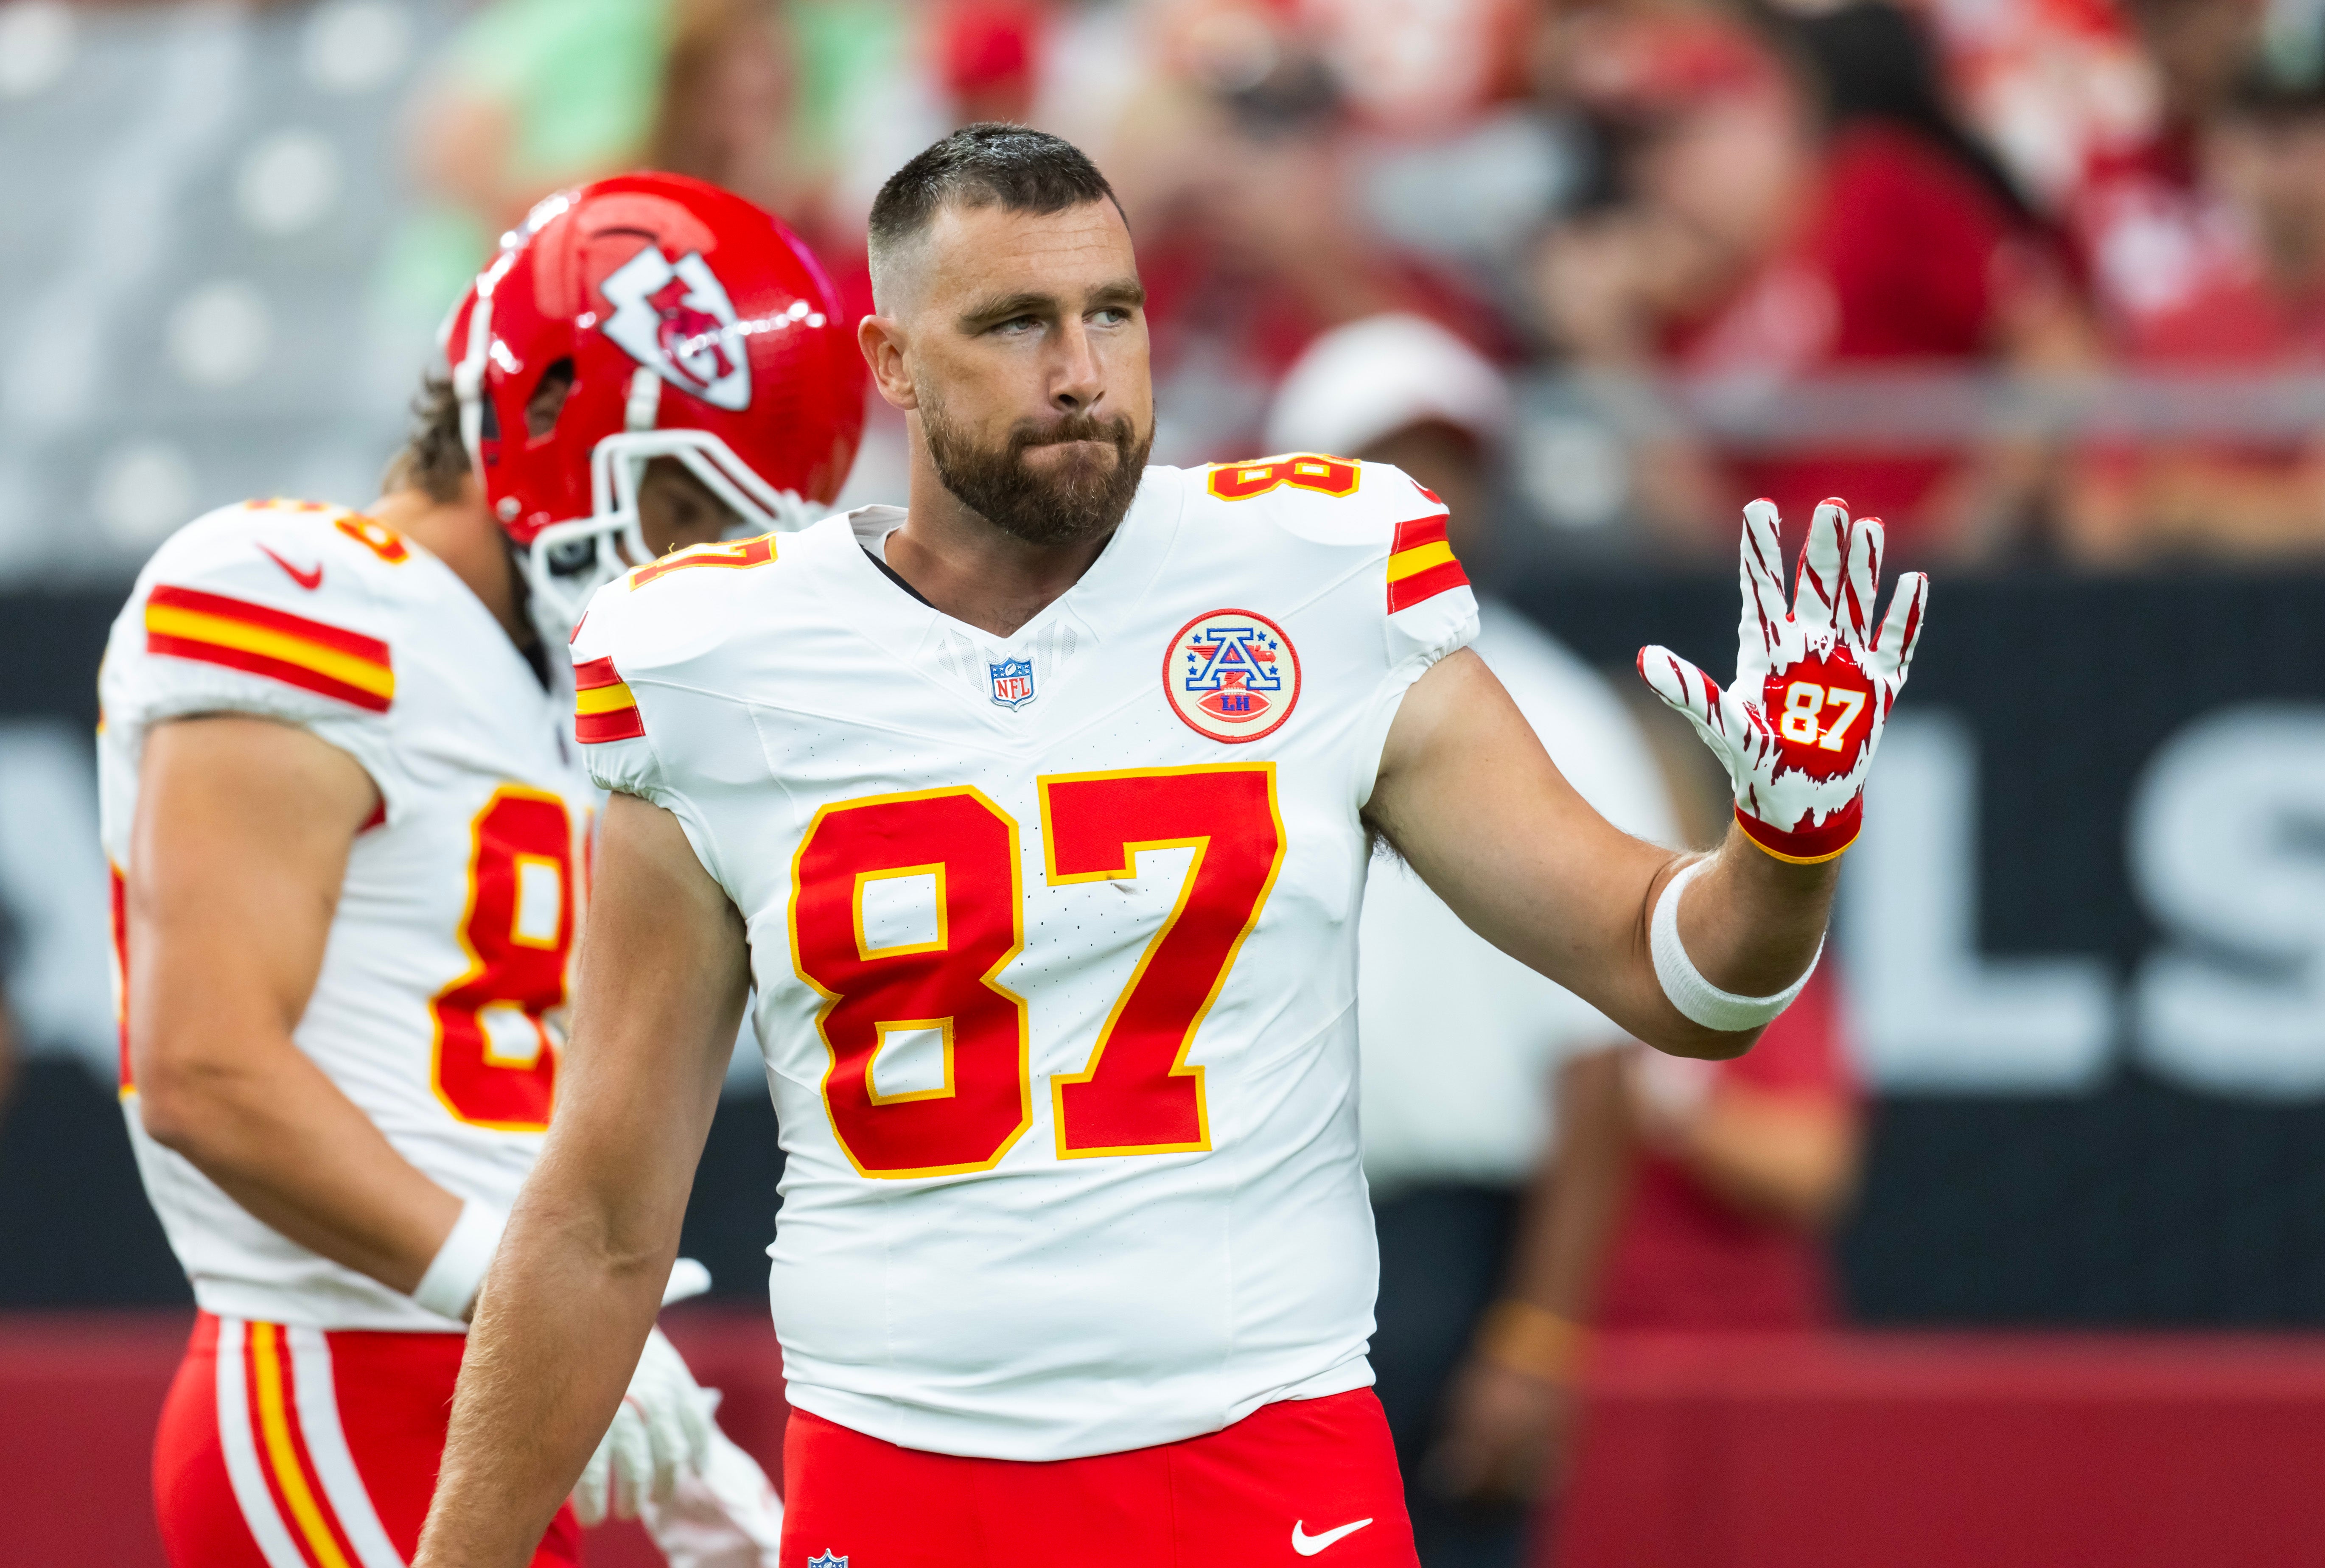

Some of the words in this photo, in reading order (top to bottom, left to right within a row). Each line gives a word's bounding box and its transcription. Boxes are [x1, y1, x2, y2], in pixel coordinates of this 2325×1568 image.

[1207, 451, 1361, 502] 8
[629, 531, 779, 592] 7
[996, 678, 1030, 699] NFL
[1220, 695, 1250, 711] LH
[1780, 680, 1867, 753] 87
[429, 781, 596, 1134] 8
[787, 761, 1287, 1179] 87
